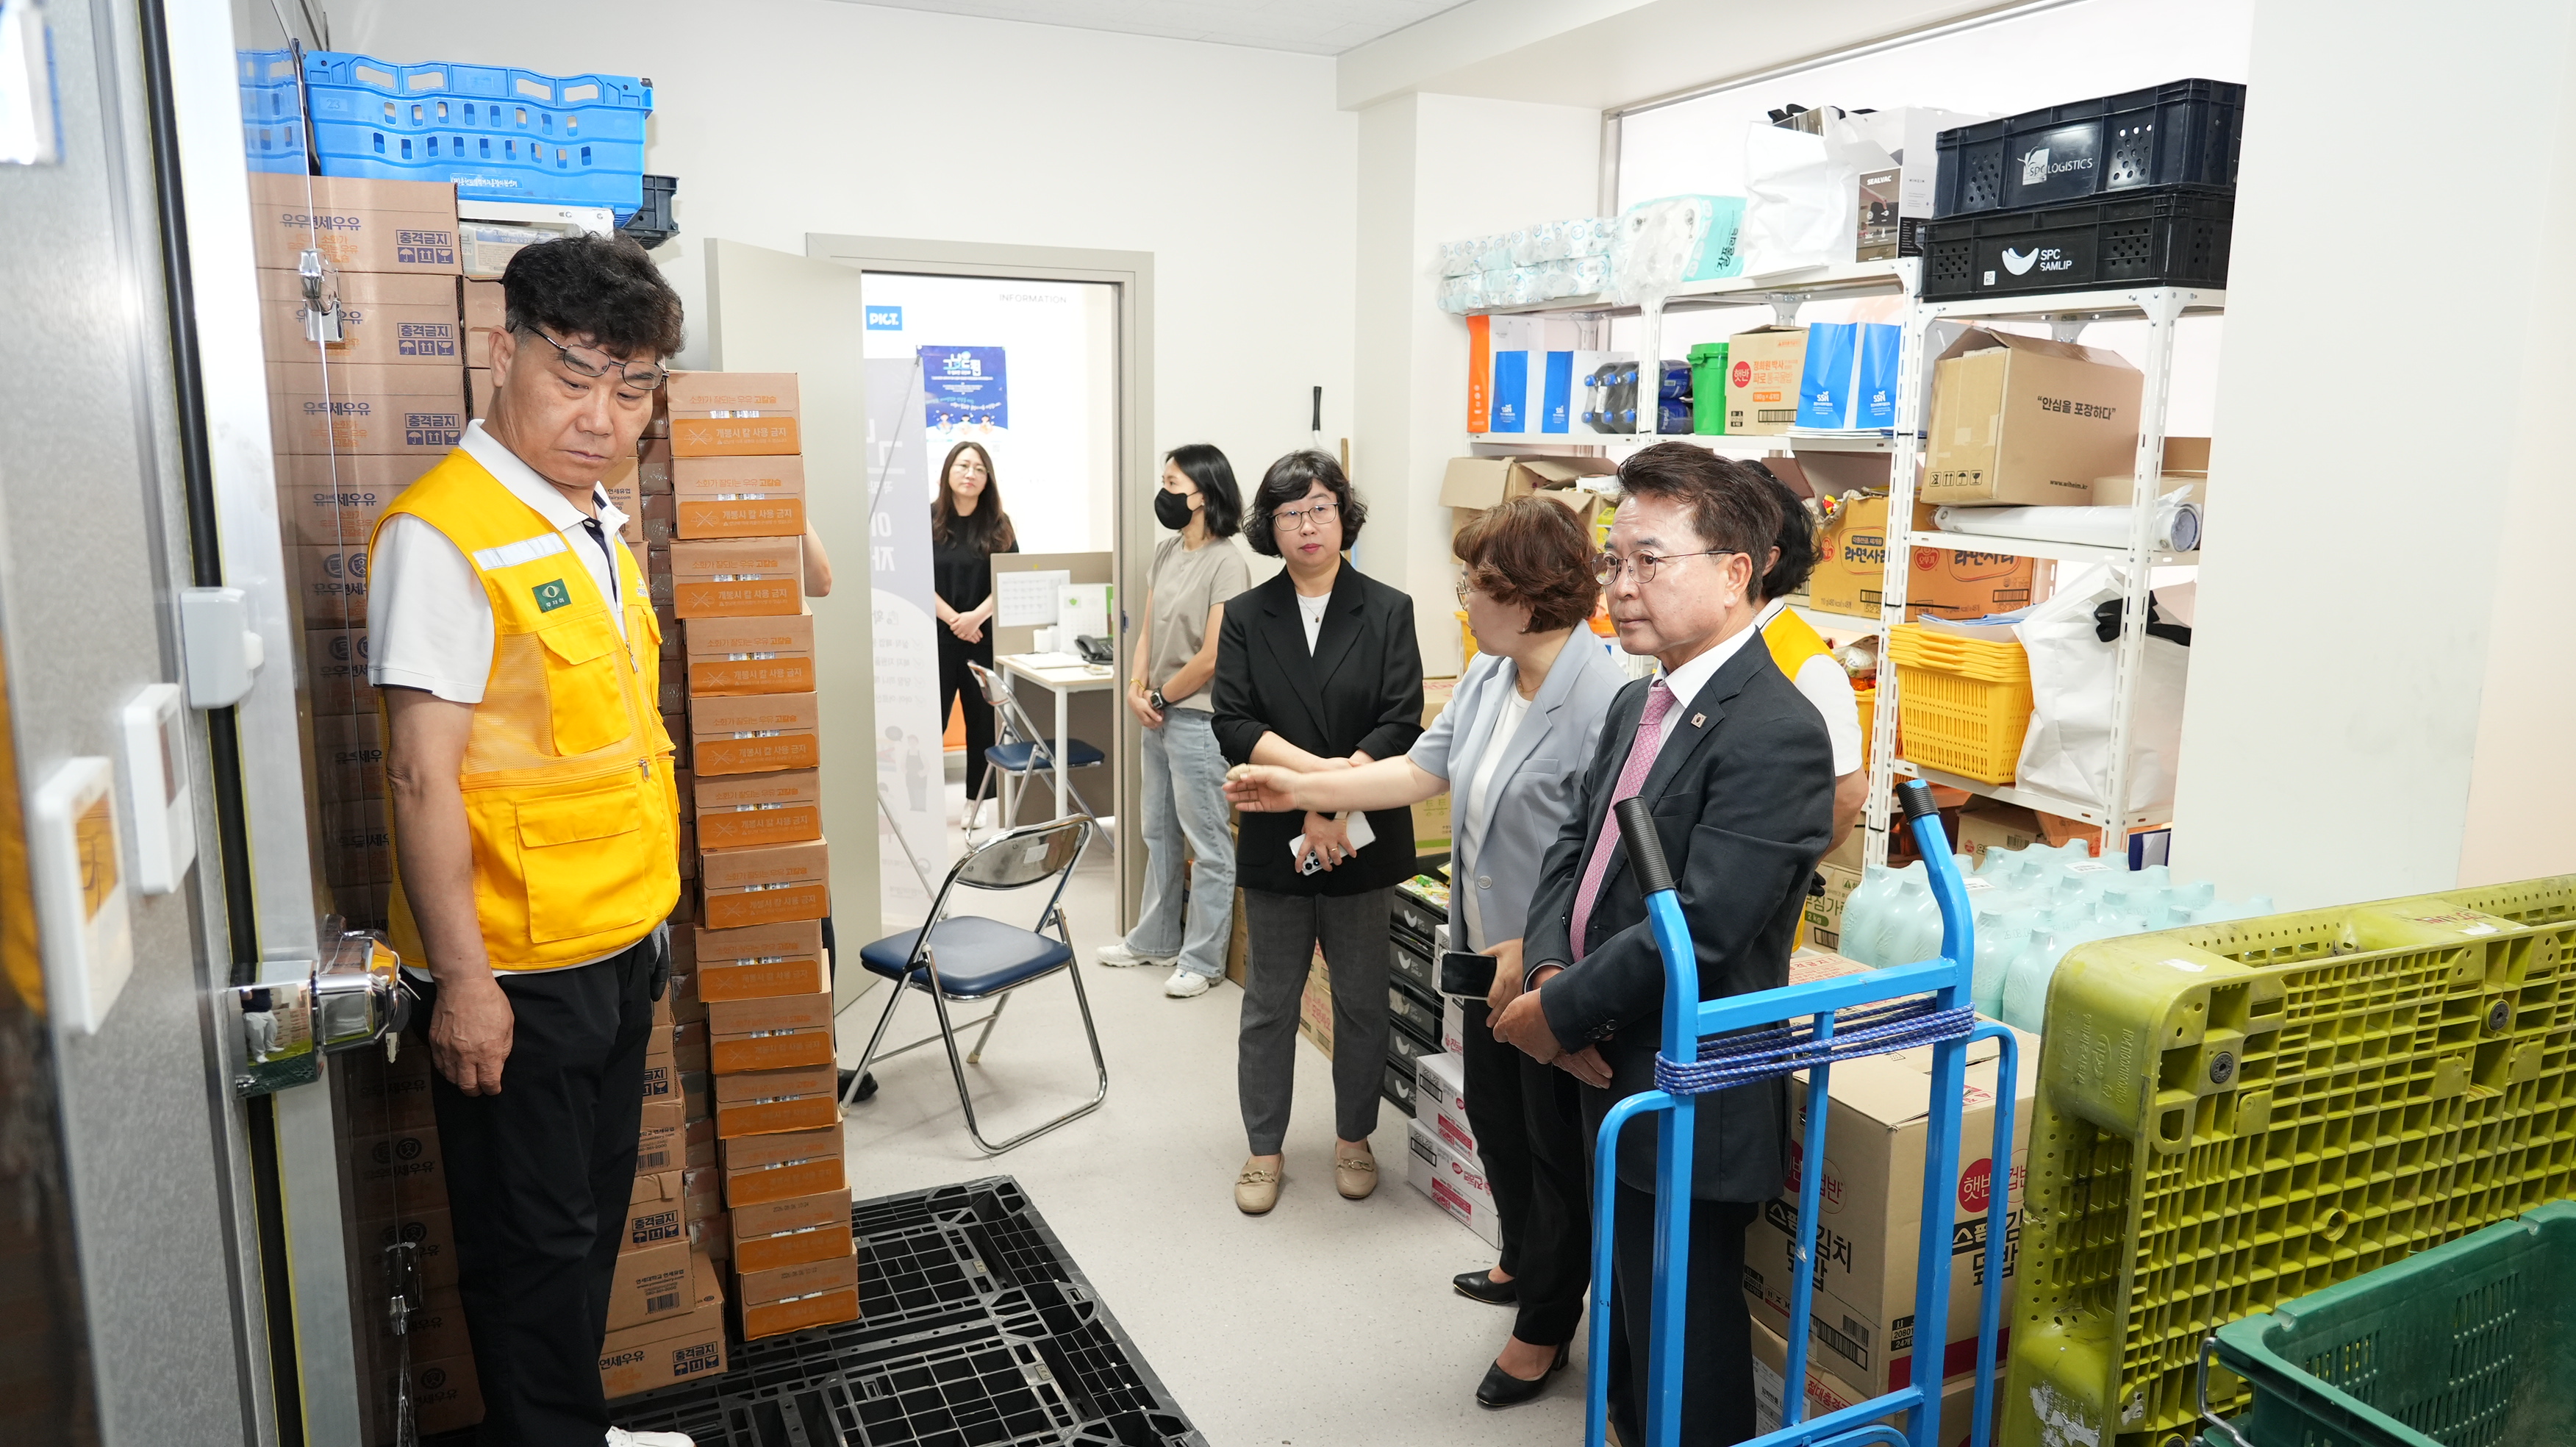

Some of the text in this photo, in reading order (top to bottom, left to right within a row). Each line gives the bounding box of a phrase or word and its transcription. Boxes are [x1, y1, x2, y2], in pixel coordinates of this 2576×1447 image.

[326, 99, 340, 110] 23
[2029, 157, 2093, 176] SPC LOGISTICS
[1867, 175, 1892, 186] SEALVAC
[398, 232, 448, 245] 충격금지
[341, 246, 358, 254] 우유
[2040, 249, 2061, 260] SPC
[2039, 260, 2072, 271] SAMLIP
[999, 294, 1067, 304] INFORMATION
[400, 324, 448, 337] 충격금지
[1753, 361, 1772, 371] 정희원
[1772, 360, 1784, 371] 박사
[1734, 368, 1750, 382] 햇반
[1753, 372, 1793, 385] 파로 통곡물밥
[690, 396, 712, 404] 소화가
[714, 396, 736, 404] 잘되는
[755, 396, 776, 404] 고칼슘
[1817, 393, 1830, 402] SSN
[1873, 393, 1886, 403] SSN
[2037, 396, 2117, 421] “안심을 포장하다”
[408, 415, 456, 427] 충격금지
[1661, 408, 1670, 430] PEPSI
[716, 428, 787, 437] 개봉시 칼 사용 금지
[723, 509, 792, 519] 개봉시 칼 사용 금지
[716, 560, 737, 568] 잘되는
[756, 560, 778, 568] 고칼슘
[1919, 556, 1935, 564] 오뚜기
[719, 589, 787, 599] 개봉시 칼 사용 금지
[707, 639, 729, 647] 소화가
[770, 637, 792, 645] 고칼슘
[734, 668, 801, 679] 개봉시 칼 사용 금지
[713, 718, 734, 726] 소화가
[737, 718, 757, 726] 잘되는
[759, 716, 773, 724] 우유
[739, 746, 806, 757] 개봉시 칼 사용 금지
[716, 792, 737, 800] 소화가
[742, 815, 807, 829] 개봉시 칼 사용 금지
[1813, 914, 1822, 924] kg
[1464, 1171, 1484, 1190] 진라면
[634, 1213, 675, 1229] 충격금지
[635, 1269, 684, 1285] 연세대학교 연세유업
[676, 1344, 715, 1359] 충격금지
[598, 1351, 645, 1370] 연세우유
